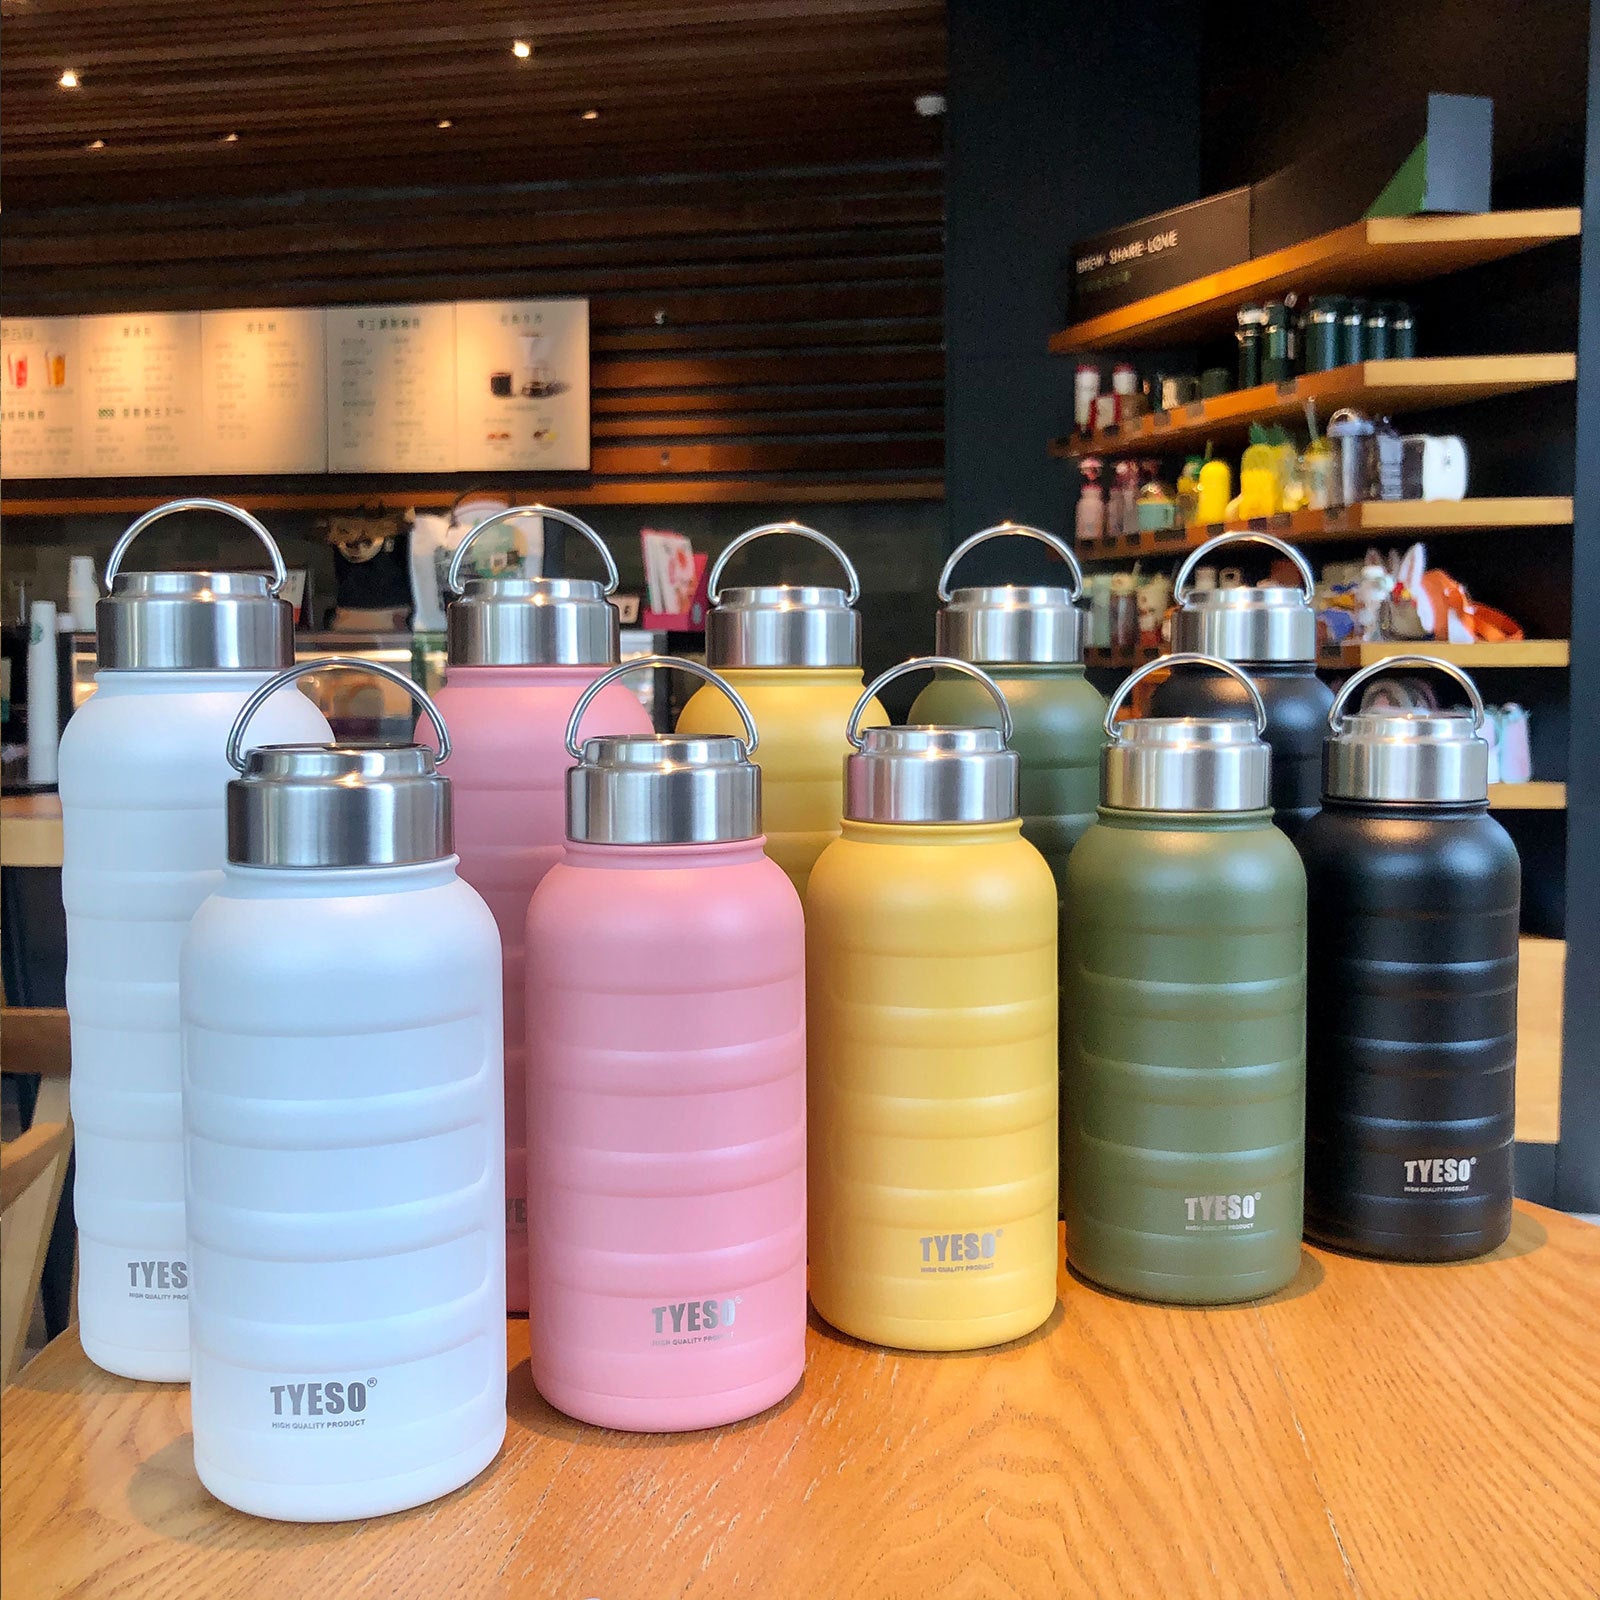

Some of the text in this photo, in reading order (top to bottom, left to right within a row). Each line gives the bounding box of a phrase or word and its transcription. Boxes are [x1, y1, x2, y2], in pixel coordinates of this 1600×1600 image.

[1109, 240, 1145, 265] SHARE
[1147, 229, 1178, 253] LOVE
[128, 1261, 188, 1289] TYES
[673, 1337, 702, 1345] QUALITY
[292, 1422, 325, 1430] QUALITY
[326, 1419, 366, 1428] PRODUCT
